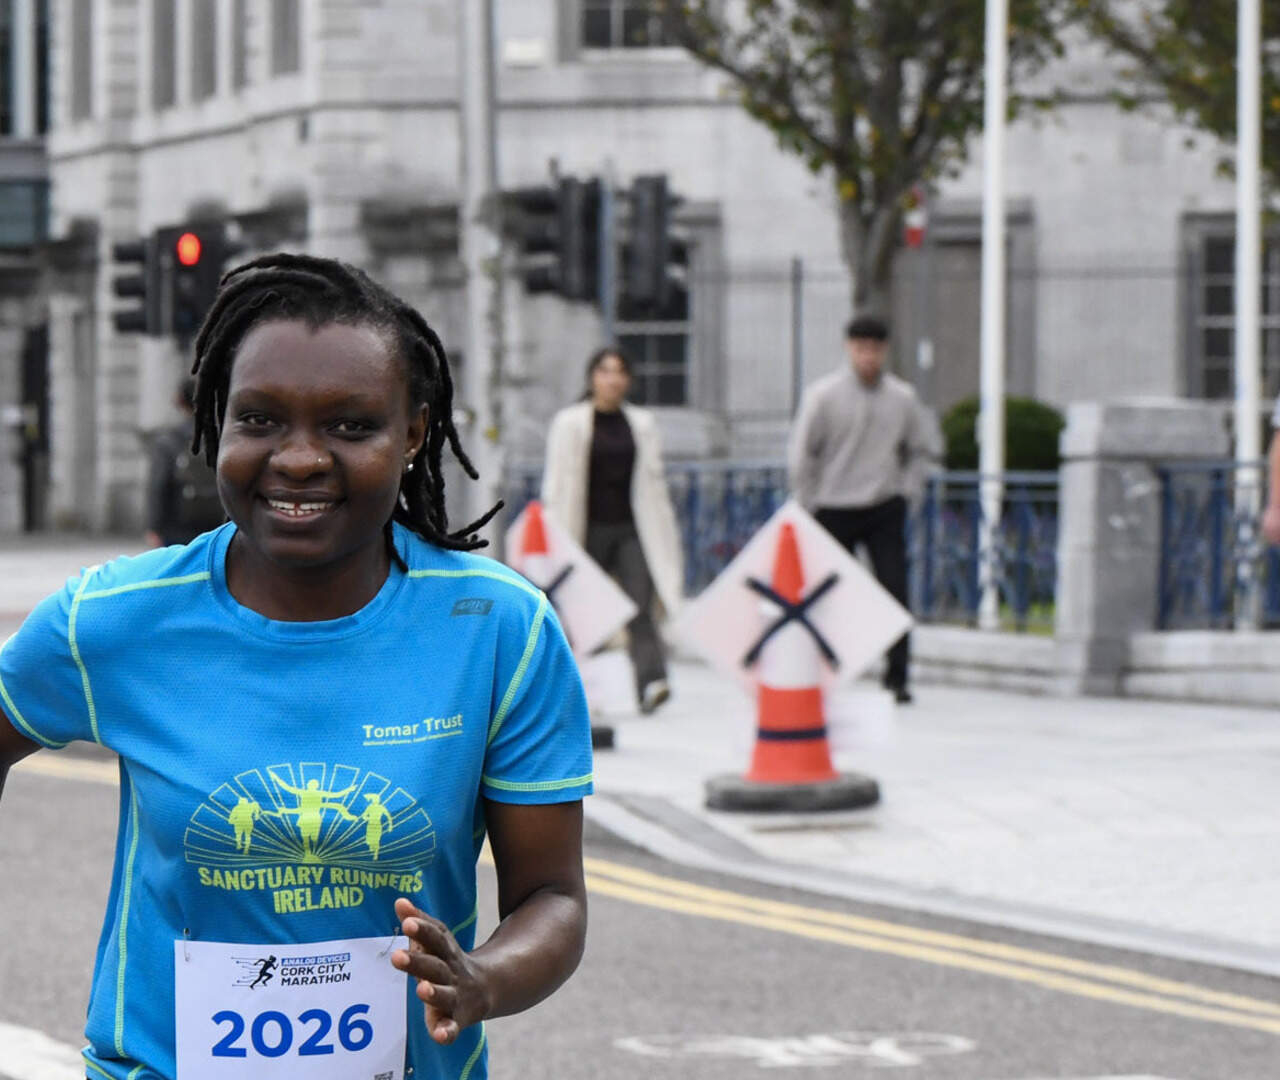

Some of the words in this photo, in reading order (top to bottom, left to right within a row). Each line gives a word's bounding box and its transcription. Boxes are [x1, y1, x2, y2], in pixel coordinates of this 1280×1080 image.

[362, 724, 420, 739] Tomar
[423, 714, 464, 732] Trust
[197, 866, 324, 890] SANCTUARY
[330, 868, 423, 893] RUNNERS
[273, 887, 364, 914] IRELAND
[280, 967, 315, 977] CORK
[317, 963, 346, 975] CITY
[280, 972, 351, 987] MARATHON
[211, 1003, 374, 1058] 2026
